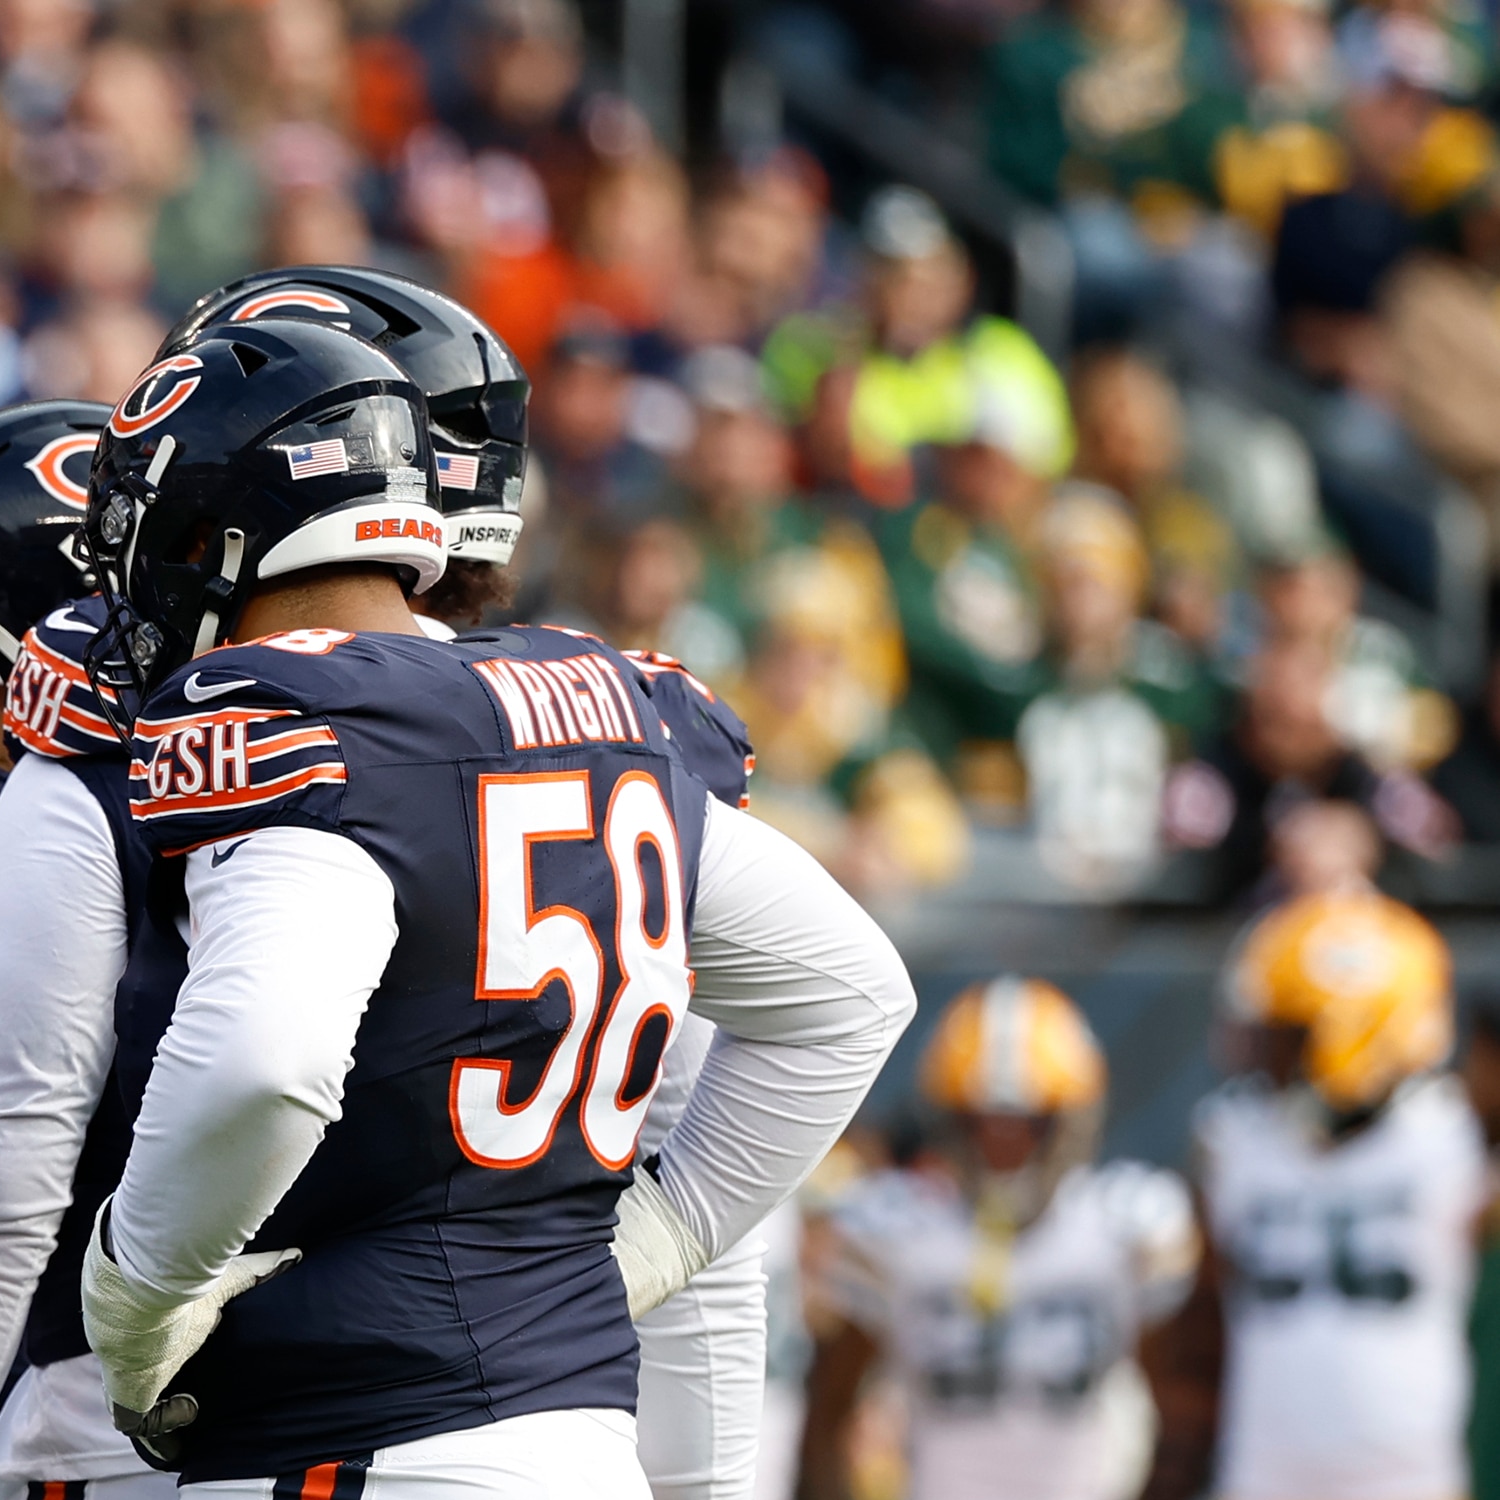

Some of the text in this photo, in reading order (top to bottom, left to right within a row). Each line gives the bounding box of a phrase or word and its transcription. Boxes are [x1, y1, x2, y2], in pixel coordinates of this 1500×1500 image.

[355, 518, 442, 548] BEARS
[459, 526, 510, 545] INSPIRE
[472, 653, 645, 751] WRIGHT
[149, 721, 250, 799] GSH
[449, 769, 695, 1171] 58
